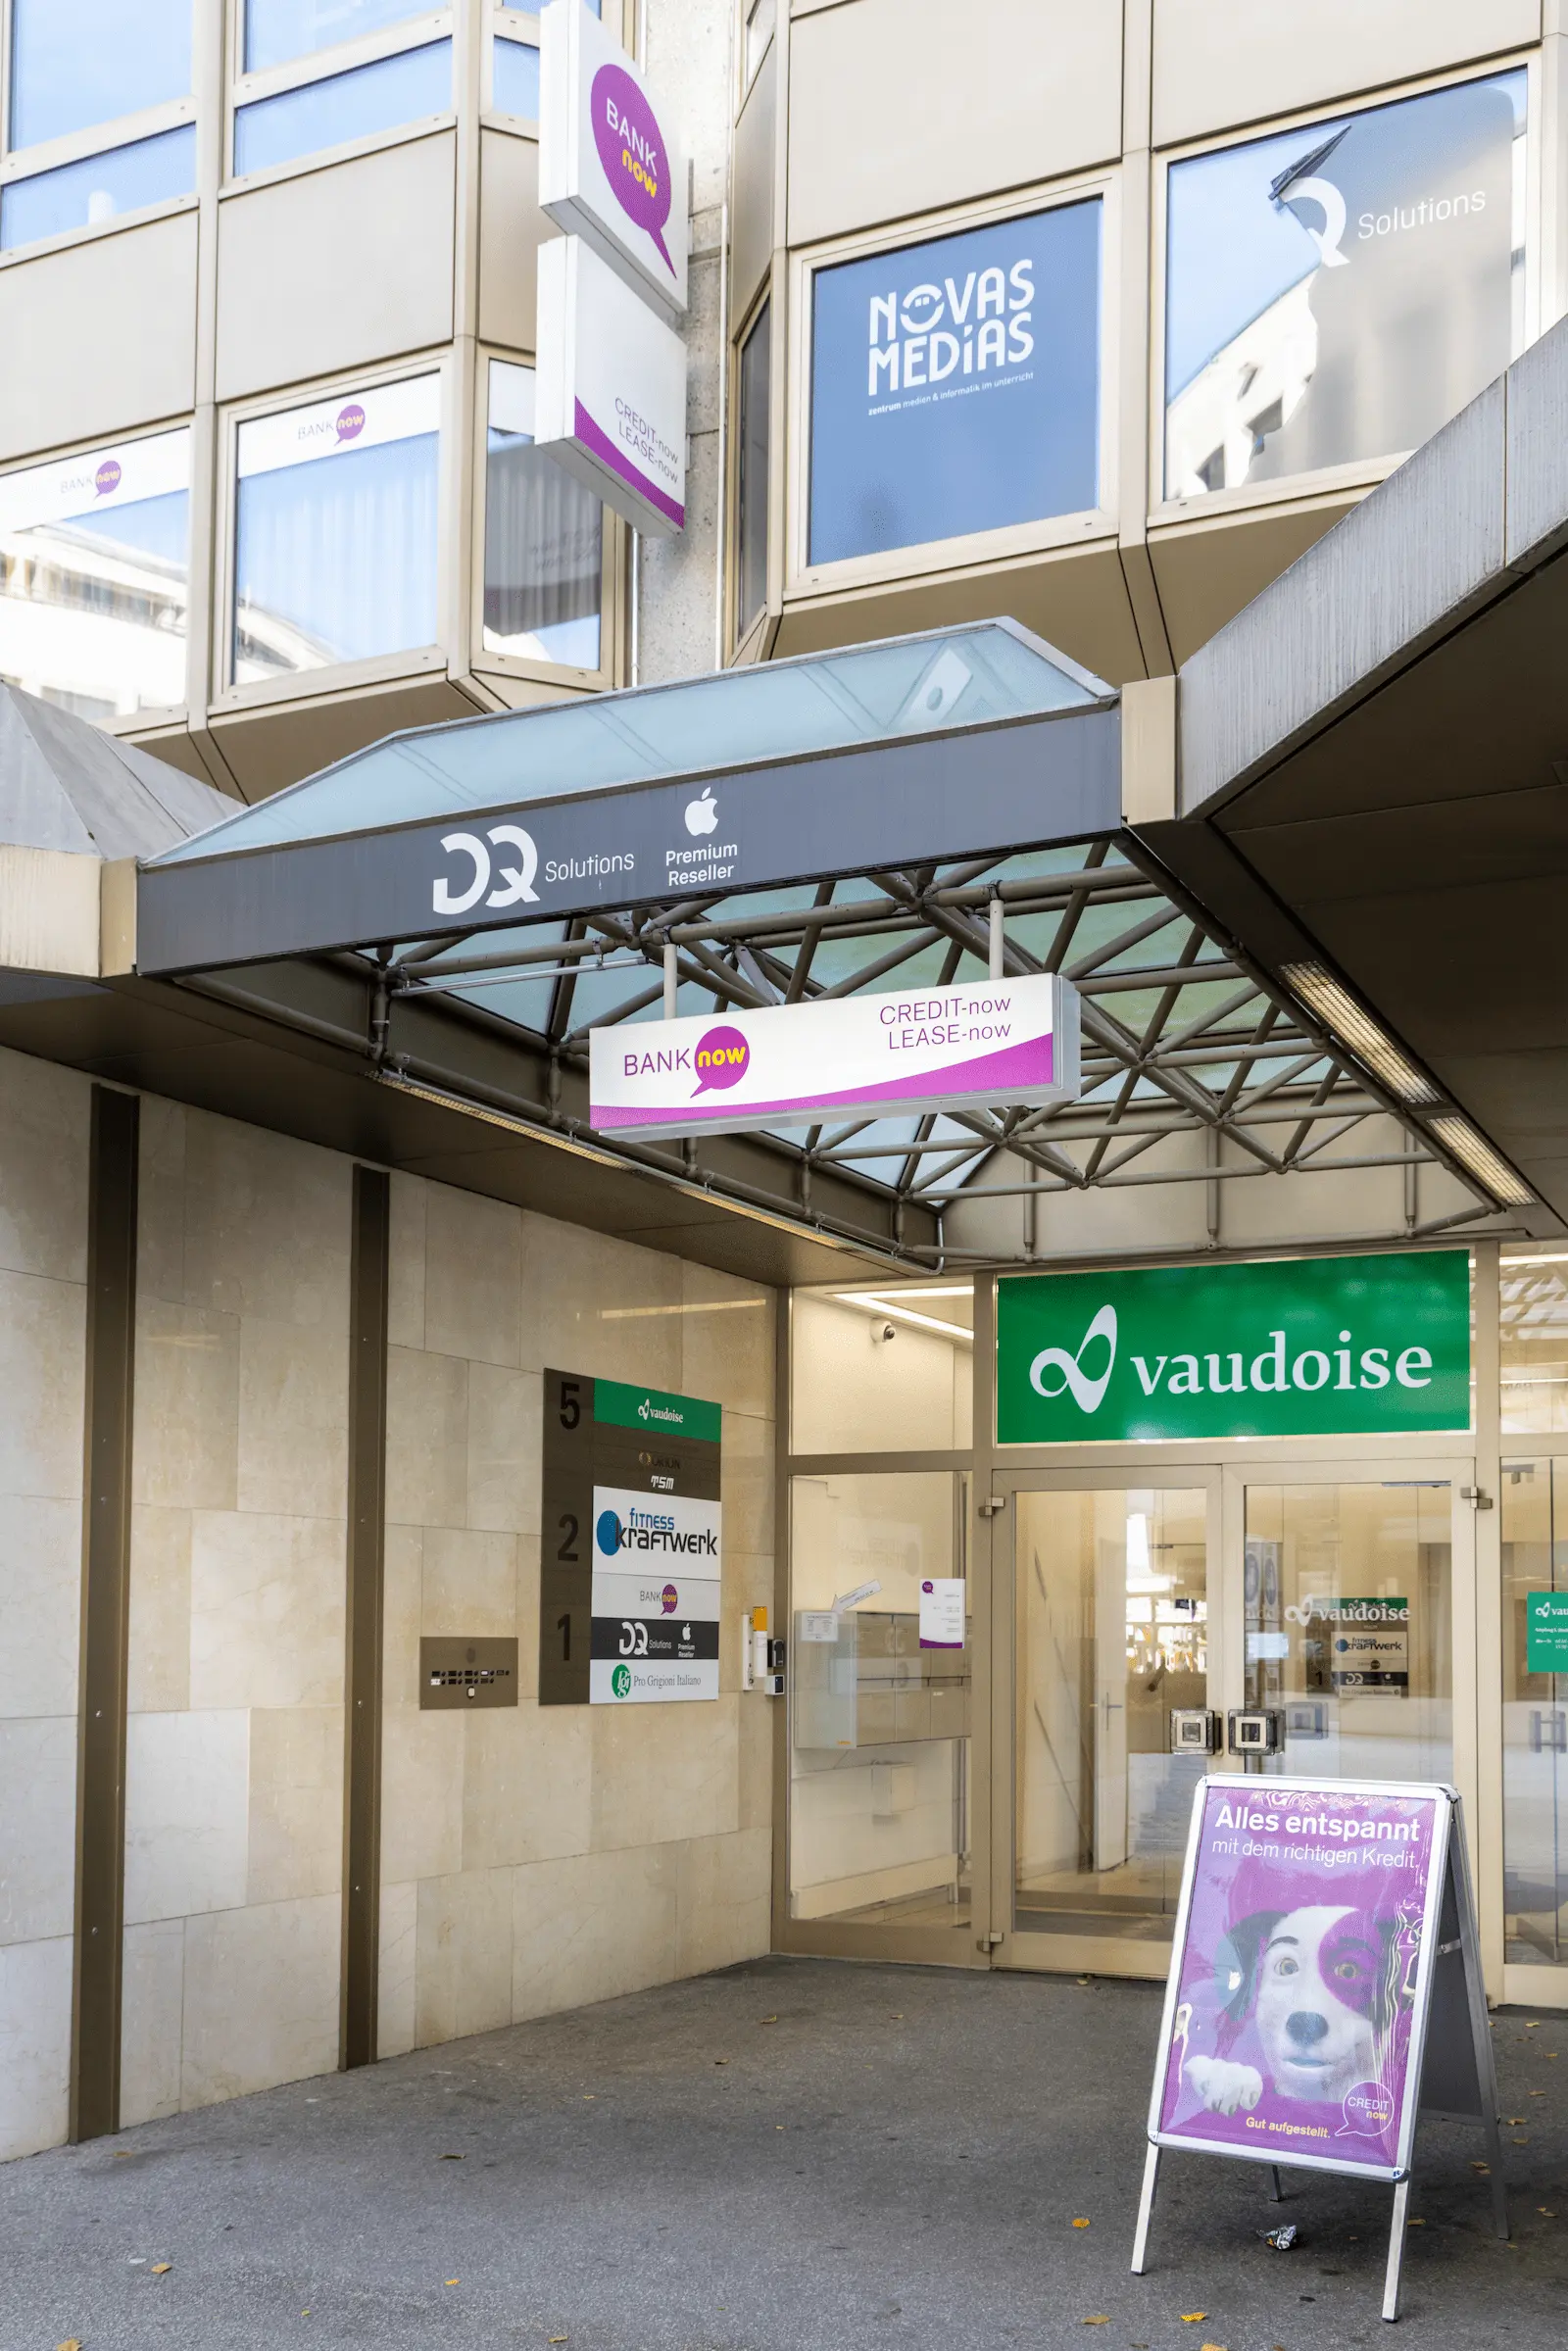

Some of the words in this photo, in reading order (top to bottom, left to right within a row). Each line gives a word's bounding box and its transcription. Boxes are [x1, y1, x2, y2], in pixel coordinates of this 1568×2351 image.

[606, 97, 658, 177] BANK
[622, 149, 658, 198] now
[1357, 190, 1487, 239] Solutions
[869, 259, 1035, 345] NOVAS
[868, 401, 902, 416] zentrum
[903, 394, 931, 409] medien
[932, 392, 939, 402] &
[940, 384, 981, 400] informatik
[982, 380, 993, 390] im
[994, 371, 1035, 388] unterricht
[297, 418, 334, 440] BANK
[338, 414, 364, 430] now
[614, 397, 679, 465] CREDIT-now
[618, 419, 678, 484] LEASE-now
[545, 853, 635, 882] Solutions
[665, 843, 738, 866] Premium
[667, 863, 734, 887] Reseller
[880, 997, 1011, 1025] CREDIT-now
[888, 1022, 1011, 1050] LEASE-now
[624, 1048, 692, 1077] BANK
[697, 1045, 747, 1069] now
[1129, 1330, 1433, 1396] vaudoise
[560, 1381, 580, 1430] 5
[650, 1405, 684, 1424] vaudoise
[557, 1513, 579, 1561] 2
[640, 1591, 662, 1602] BANK
[662, 1592, 678, 1603] now
[1318, 1602, 1410, 1622] vaudoise
[557, 1614, 570, 1661] 1
[633, 1675, 646, 1687] Pro
[647, 1675, 676, 1690] Grigioni
[676, 1674, 702, 1687] Italiano
[1214, 1805, 1279, 1832] Alles
[1285, 1813, 1421, 1841] entspannt
[1211, 1837, 1239, 1855] mit
[1242, 1839, 1279, 1857] dem
[1283, 1842, 1357, 1867] richtigen
[1362, 1847, 1420, 1869] Kredit.
[1348, 2096, 1390, 2111] CREDIT
[1366, 2110, 1388, 2121] now
[1246, 2117, 1267, 2130] Gut
[1268, 2121, 1331, 2138] aufgestellt.
